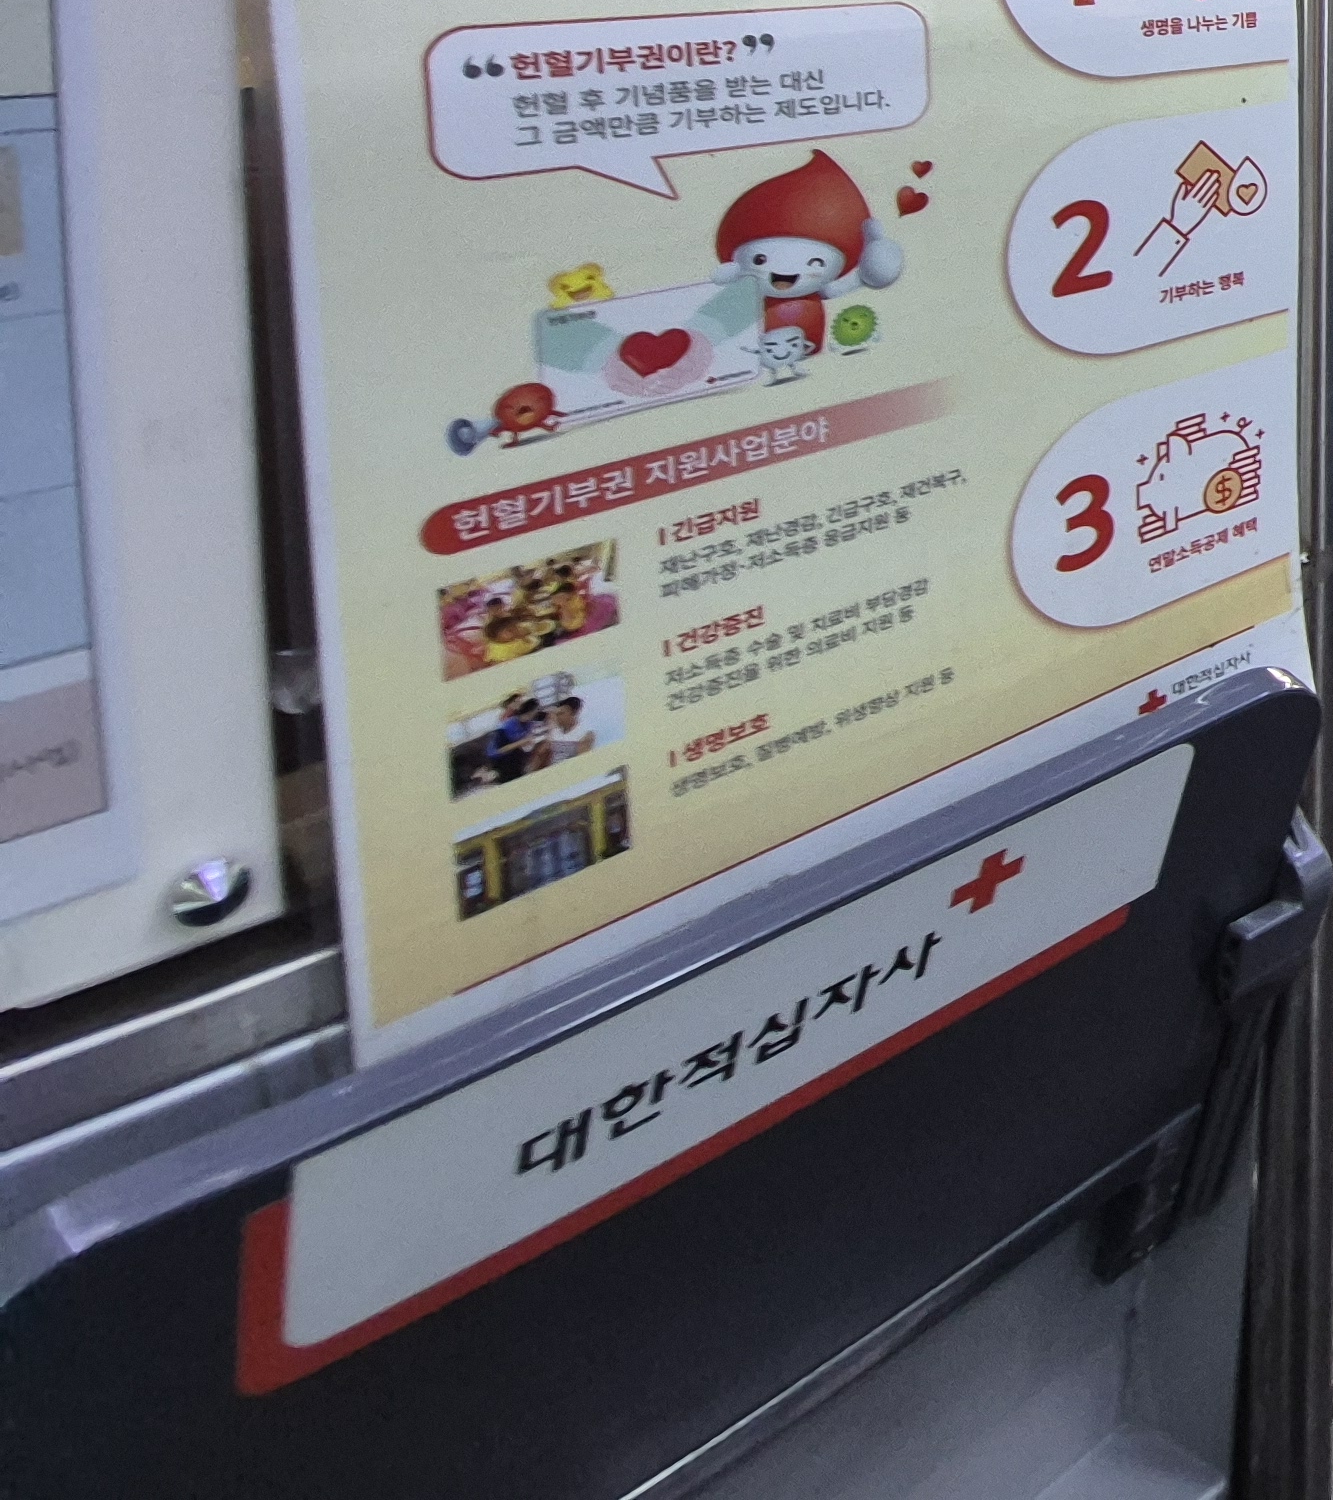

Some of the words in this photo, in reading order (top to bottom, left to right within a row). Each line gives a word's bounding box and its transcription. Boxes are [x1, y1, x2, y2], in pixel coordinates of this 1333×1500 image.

[1140, 17, 1184, 37] 생명을
[1187, 15, 1228, 33] 나누는
[1231, 11, 1258, 29] 기쁨
[512, 90, 568, 119] 헌혈
[580, 88, 605, 113] 후
[615, 76, 717, 108] 기념품을
[725, 71, 773, 98] 받는
[779, 68, 825, 93] 대신
[514, 125, 543, 148] 그
[552, 112, 660, 146] 금액만큼
[670, 102, 766, 133] 기부하는
[774, 88, 891, 120] 제도입니다.
[1050, 198, 1114, 299] 2
[1159, 278, 1216, 304] 기부하는
[1218, 271, 1245, 292] 행복
[451, 465, 635, 543] 헌혈기부권
[645, 415, 831, 487] 지원사업분야
[672, 497, 761, 544] 긴급지원
[1055, 473, 1115, 574] 3
[1148, 526, 1230, 574] 연말소득공제
[1232, 516, 1258, 539] 혜택
[677, 603, 765, 653] 건강증진
[1172, 651, 1251, 696] 대한적십자사
[682, 712, 771, 763] 생명보호
[512, 929, 945, 1180] 대한적십자사
